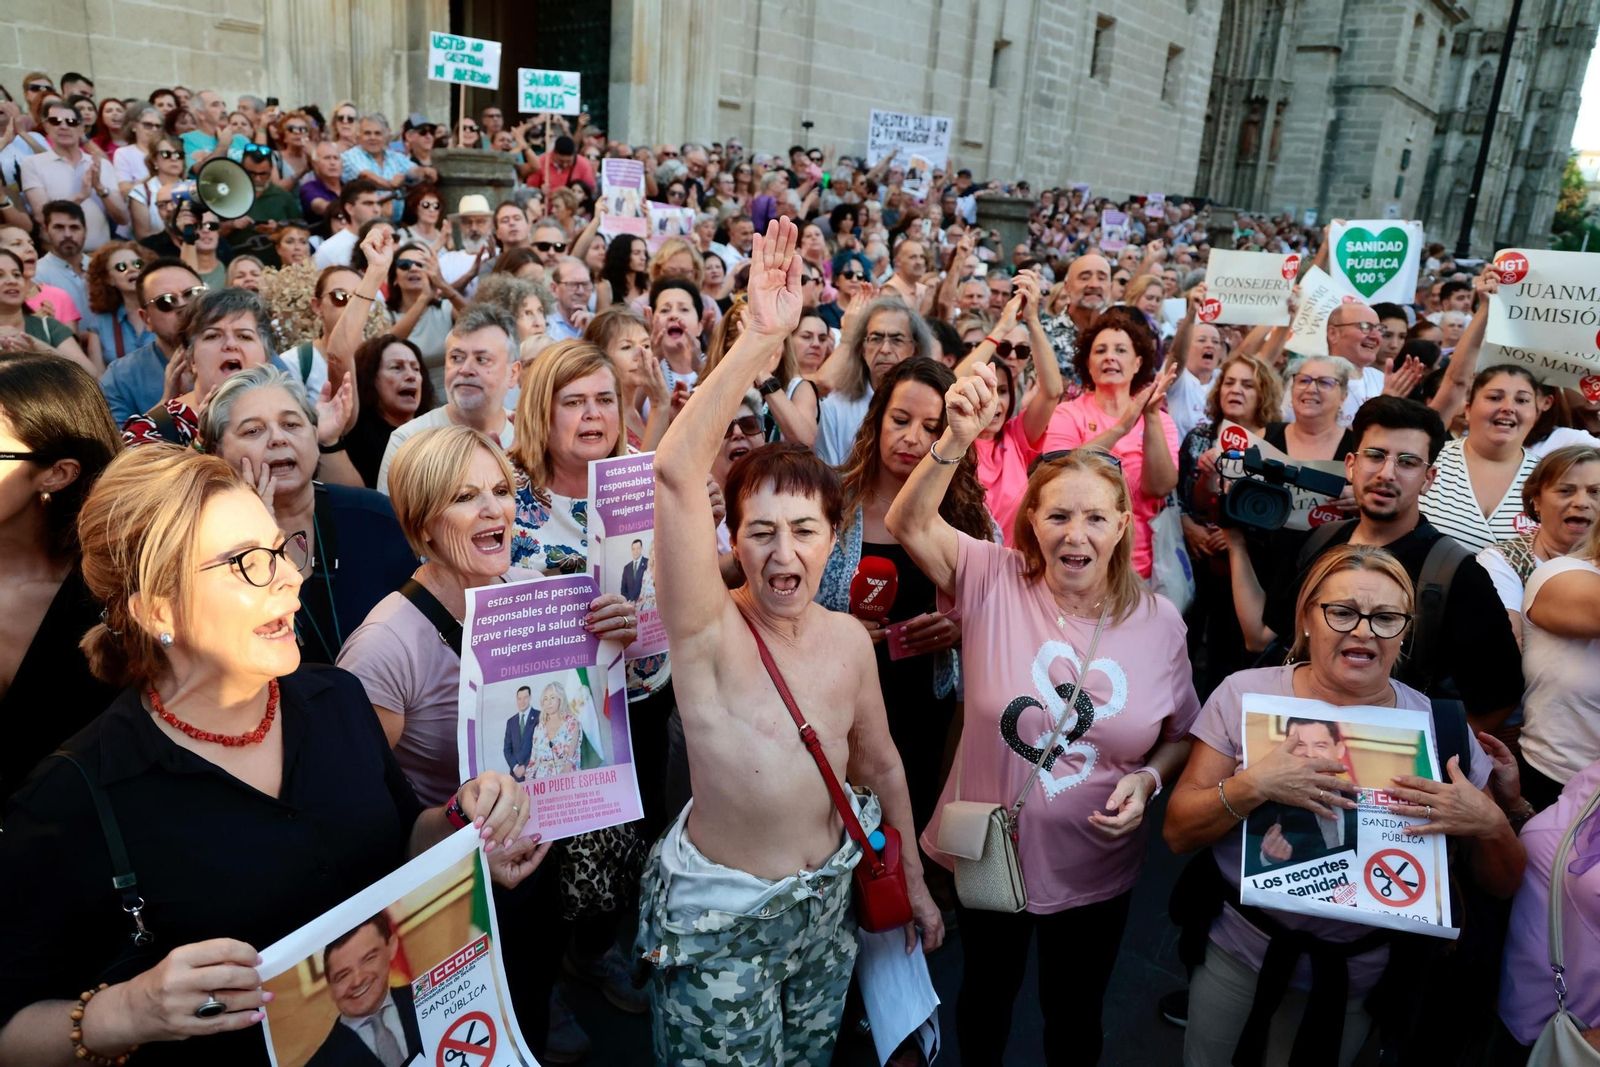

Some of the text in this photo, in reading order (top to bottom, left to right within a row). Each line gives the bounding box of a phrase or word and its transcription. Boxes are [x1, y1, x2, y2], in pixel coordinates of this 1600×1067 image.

[1345, 240, 1404, 252] SANIDAD
[1345, 255, 1399, 270] PÚBLICA
[1214, 275, 1291, 292] CONSEJERA
[1355, 272, 1387, 284] 100 %
[1217, 291, 1281, 307] DIMISIÓN
[1516, 282, 1600, 303] JUANM
[1199, 302, 1220, 316] UGT
[1499, 345, 1537, 364] NOS
[1540, 356, 1592, 377] MATA
[1222, 429, 1248, 448] UGT
[606, 462, 654, 478] estas son las
[600, 476, 652, 492] responsables
[596, 488, 654, 508] grave riesgo la
[612, 504, 644, 517] mujeres
[488, 584, 593, 608] estas son las personas
[863, 577, 888, 604] 7
[476, 602, 590, 626] responsables de poner
[640, 612, 649, 624] NO
[472, 630, 501, 646] grave
[504, 624, 534, 640] riesgo
[537, 622, 546, 632] la
[548, 618, 576, 632] salud
[490, 634, 587, 658] mujeres andaluzas
[501, 656, 561, 678] DIMISIONES
[533, 782, 546, 796] NO
[548, 776, 577, 793] PUEDE
[579, 770, 617, 788] ESPERAR
[1361, 818, 1410, 828] SANIDAD
[1382, 830, 1425, 844] PÚBLICA
[1253, 858, 1349, 890] Los recortes
[1288, 872, 1349, 897] sanidad
[434, 946, 476, 982] CCOO
[416, 986, 438, 1003] sindicato
[421, 980, 472, 1020] SANIDAD
[443, 984, 488, 1019] PÚBLICA
